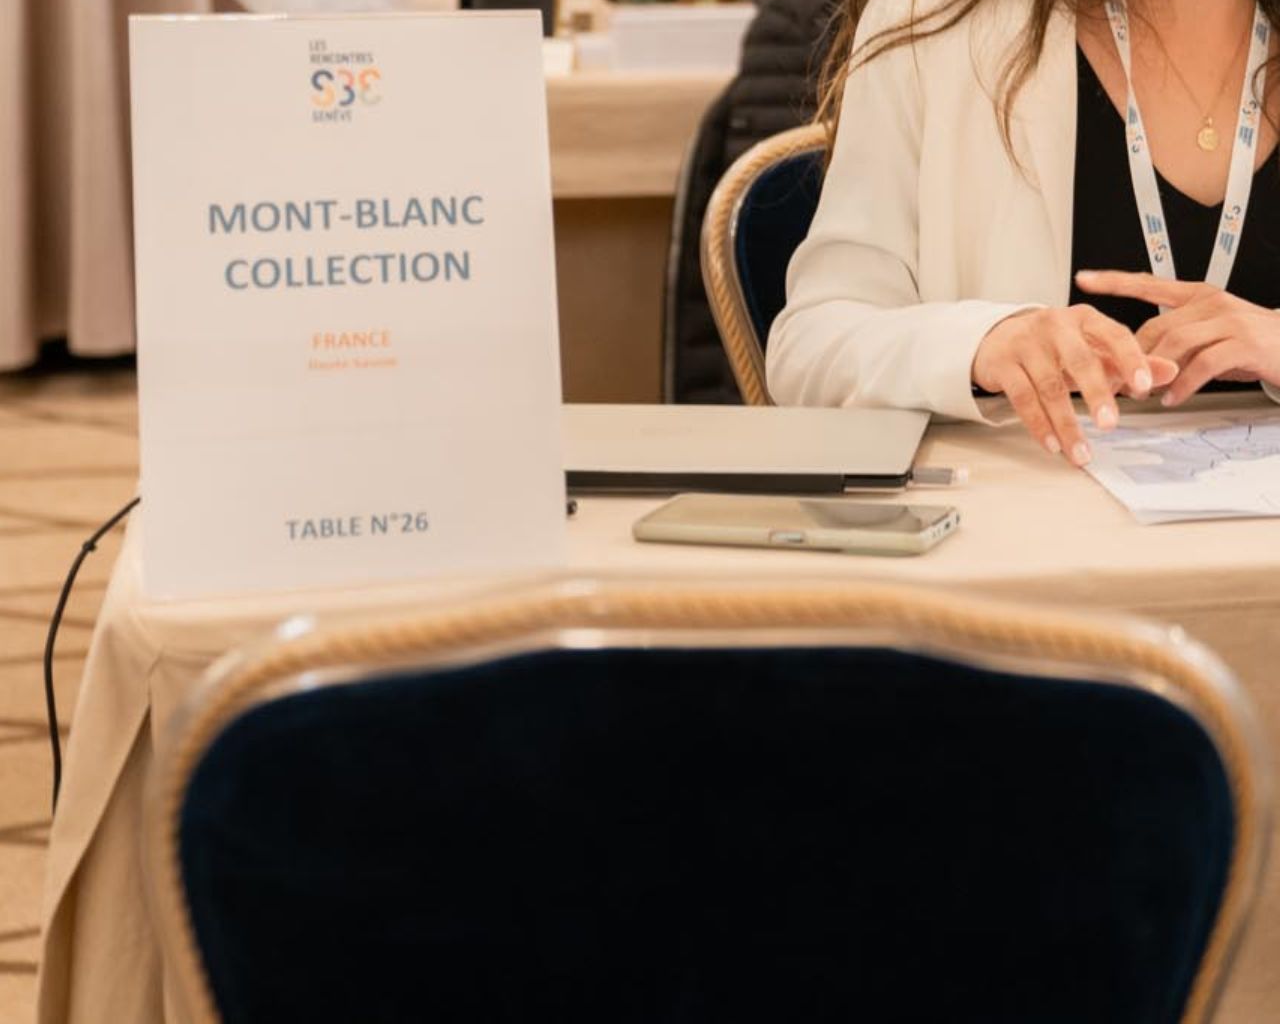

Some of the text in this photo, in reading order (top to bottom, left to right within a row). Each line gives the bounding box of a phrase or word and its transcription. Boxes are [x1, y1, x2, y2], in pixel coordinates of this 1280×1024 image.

[208, 195, 485, 234] MONT-BLANC
[224, 250, 471, 290] COLLECTION
[312, 328, 391, 350] FRANCE
[285, 510, 429, 540] TABLE N°26
